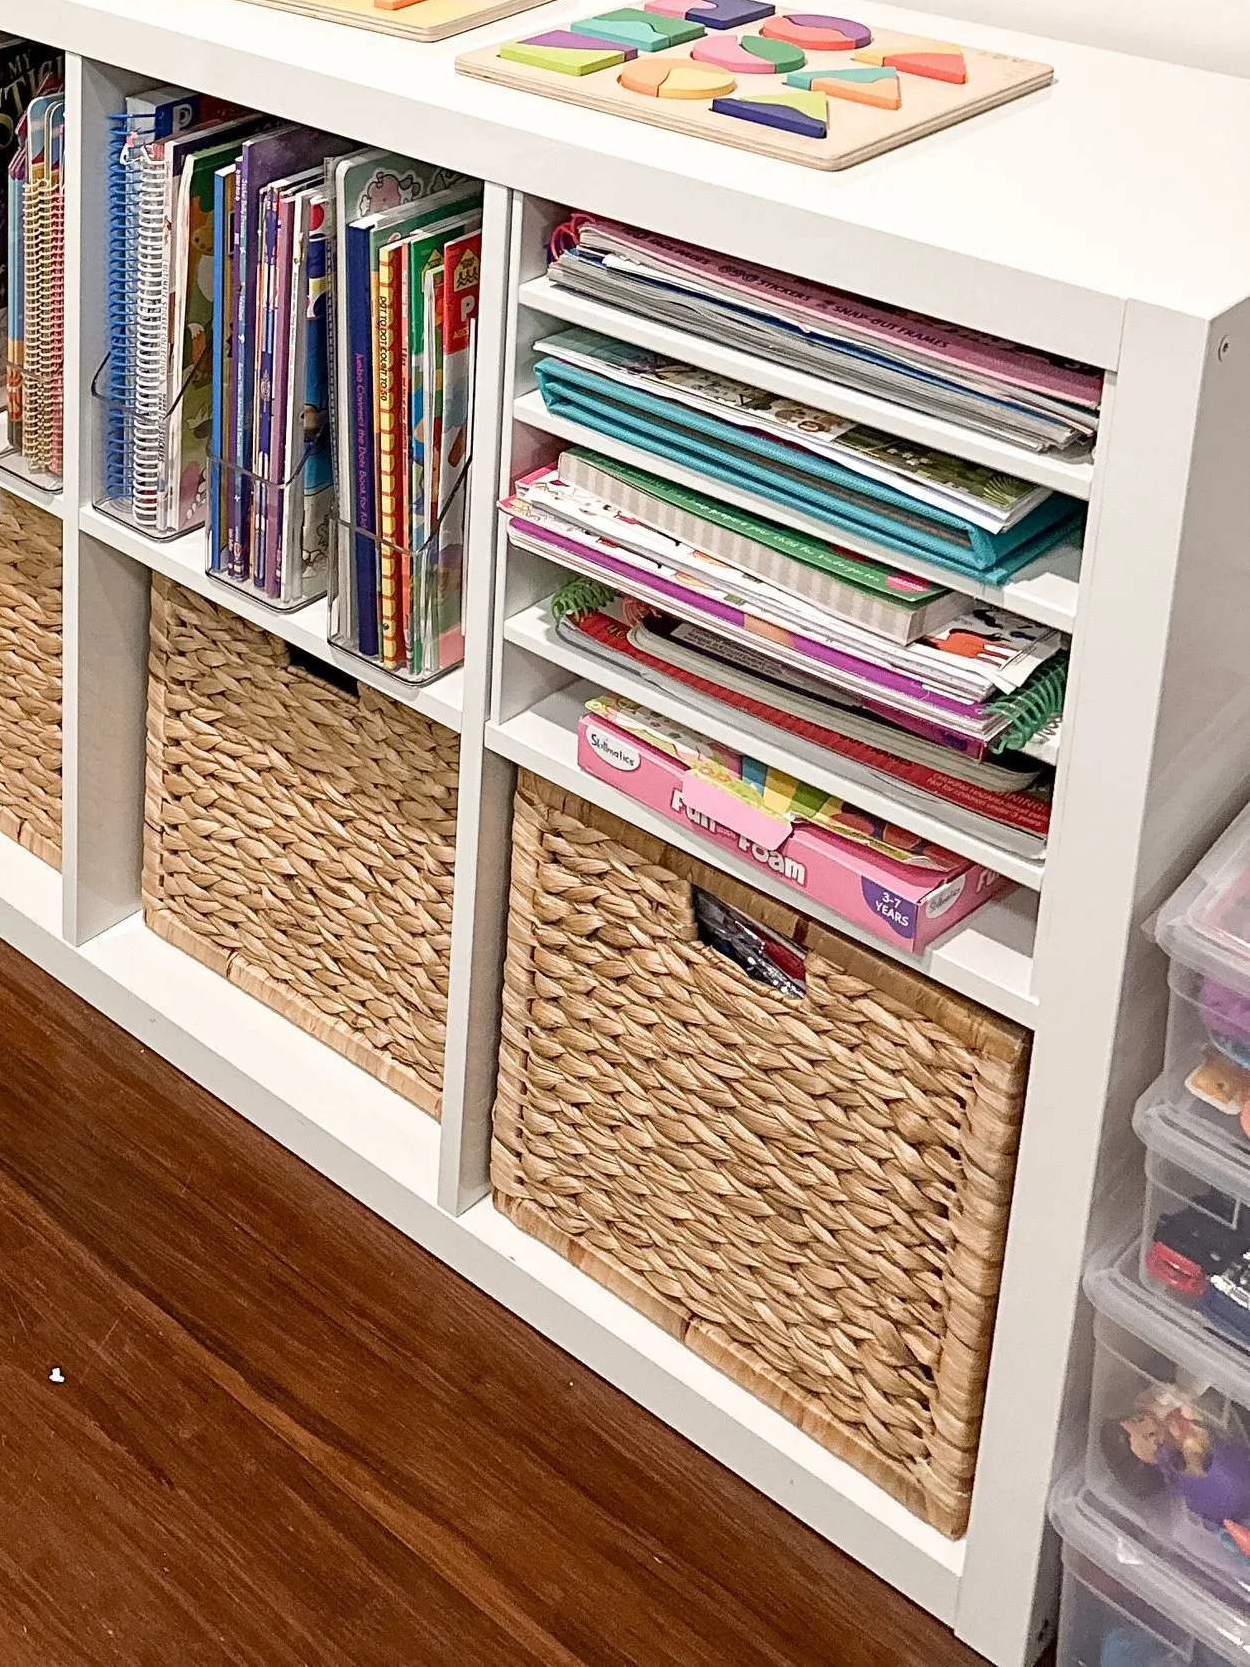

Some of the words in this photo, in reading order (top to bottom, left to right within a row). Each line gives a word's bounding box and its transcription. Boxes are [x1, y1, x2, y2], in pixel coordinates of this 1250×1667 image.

[379, 296, 387, 314] DOT
[461, 295, 475, 322] P
[354, 353, 364, 383] Jumbo
[380, 347, 388, 376] COUNT
[381, 378, 388, 389] TO
[356, 385, 367, 427] Connect
[358, 429, 367, 444] the
[357, 446, 367, 468] Dots
[359, 470, 368, 496] Book
[359, 496, 368, 510] for
[772, 533, 798, 549] child
[799, 545, 816, 556] for
[590, 733, 635, 766] Skillmatics
[739, 834, 806, 887] Foam
[882, 891, 901, 909] 3-7
[875, 900, 910, 927] YEARS
